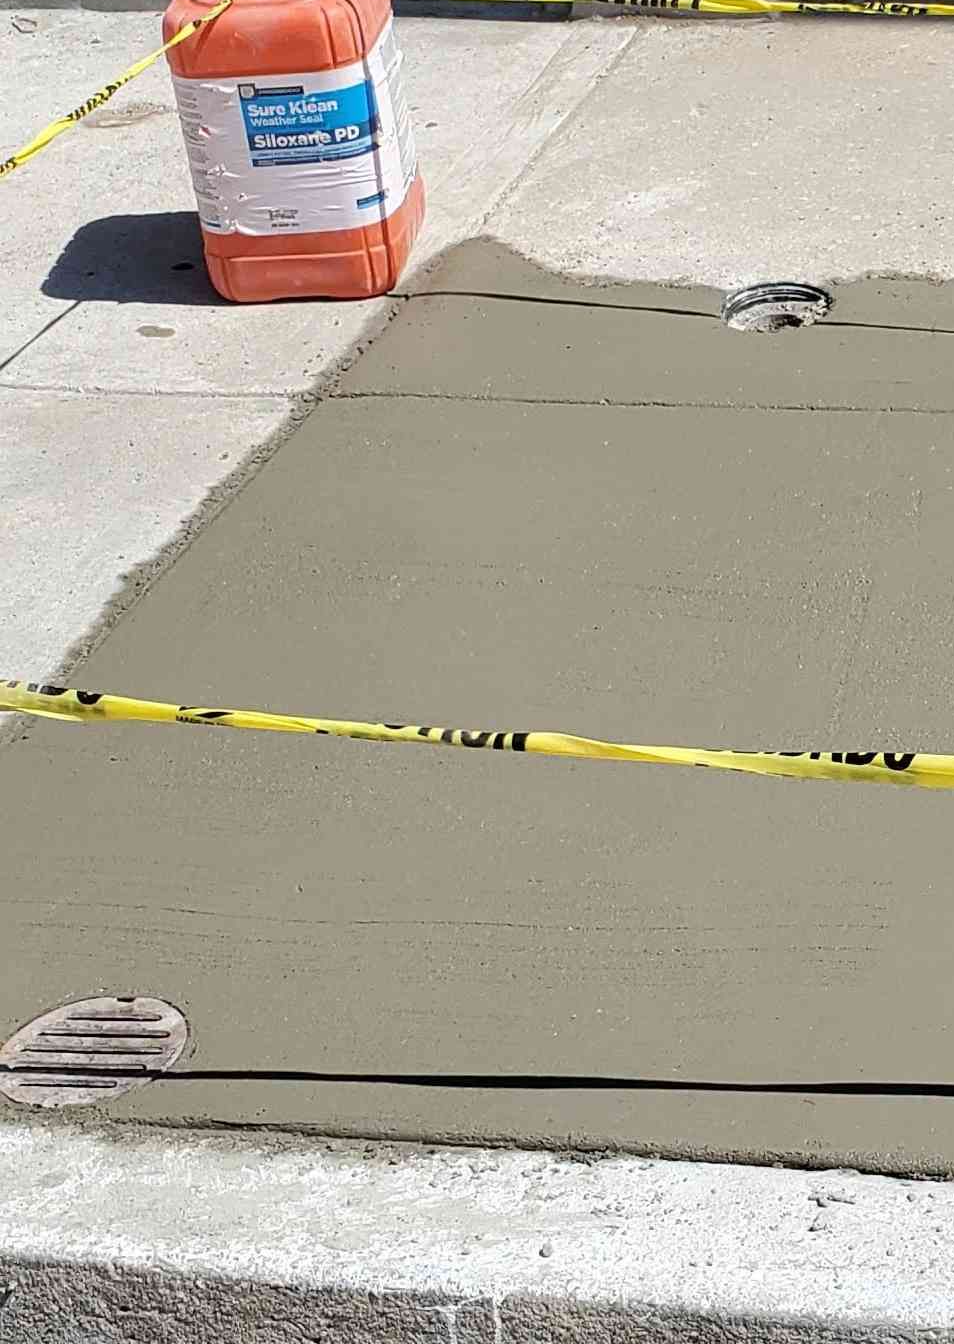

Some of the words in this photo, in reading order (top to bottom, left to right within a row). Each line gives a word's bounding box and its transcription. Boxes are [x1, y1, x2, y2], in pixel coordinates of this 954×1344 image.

[247, 104, 286, 117] Sure
[288, 100, 338, 114] Klean
[250, 116, 297, 127] Weather
[299, 114, 324, 124] Seal
[254, 130, 332, 148] Siloxane
[334, 125, 360, 142] PD
